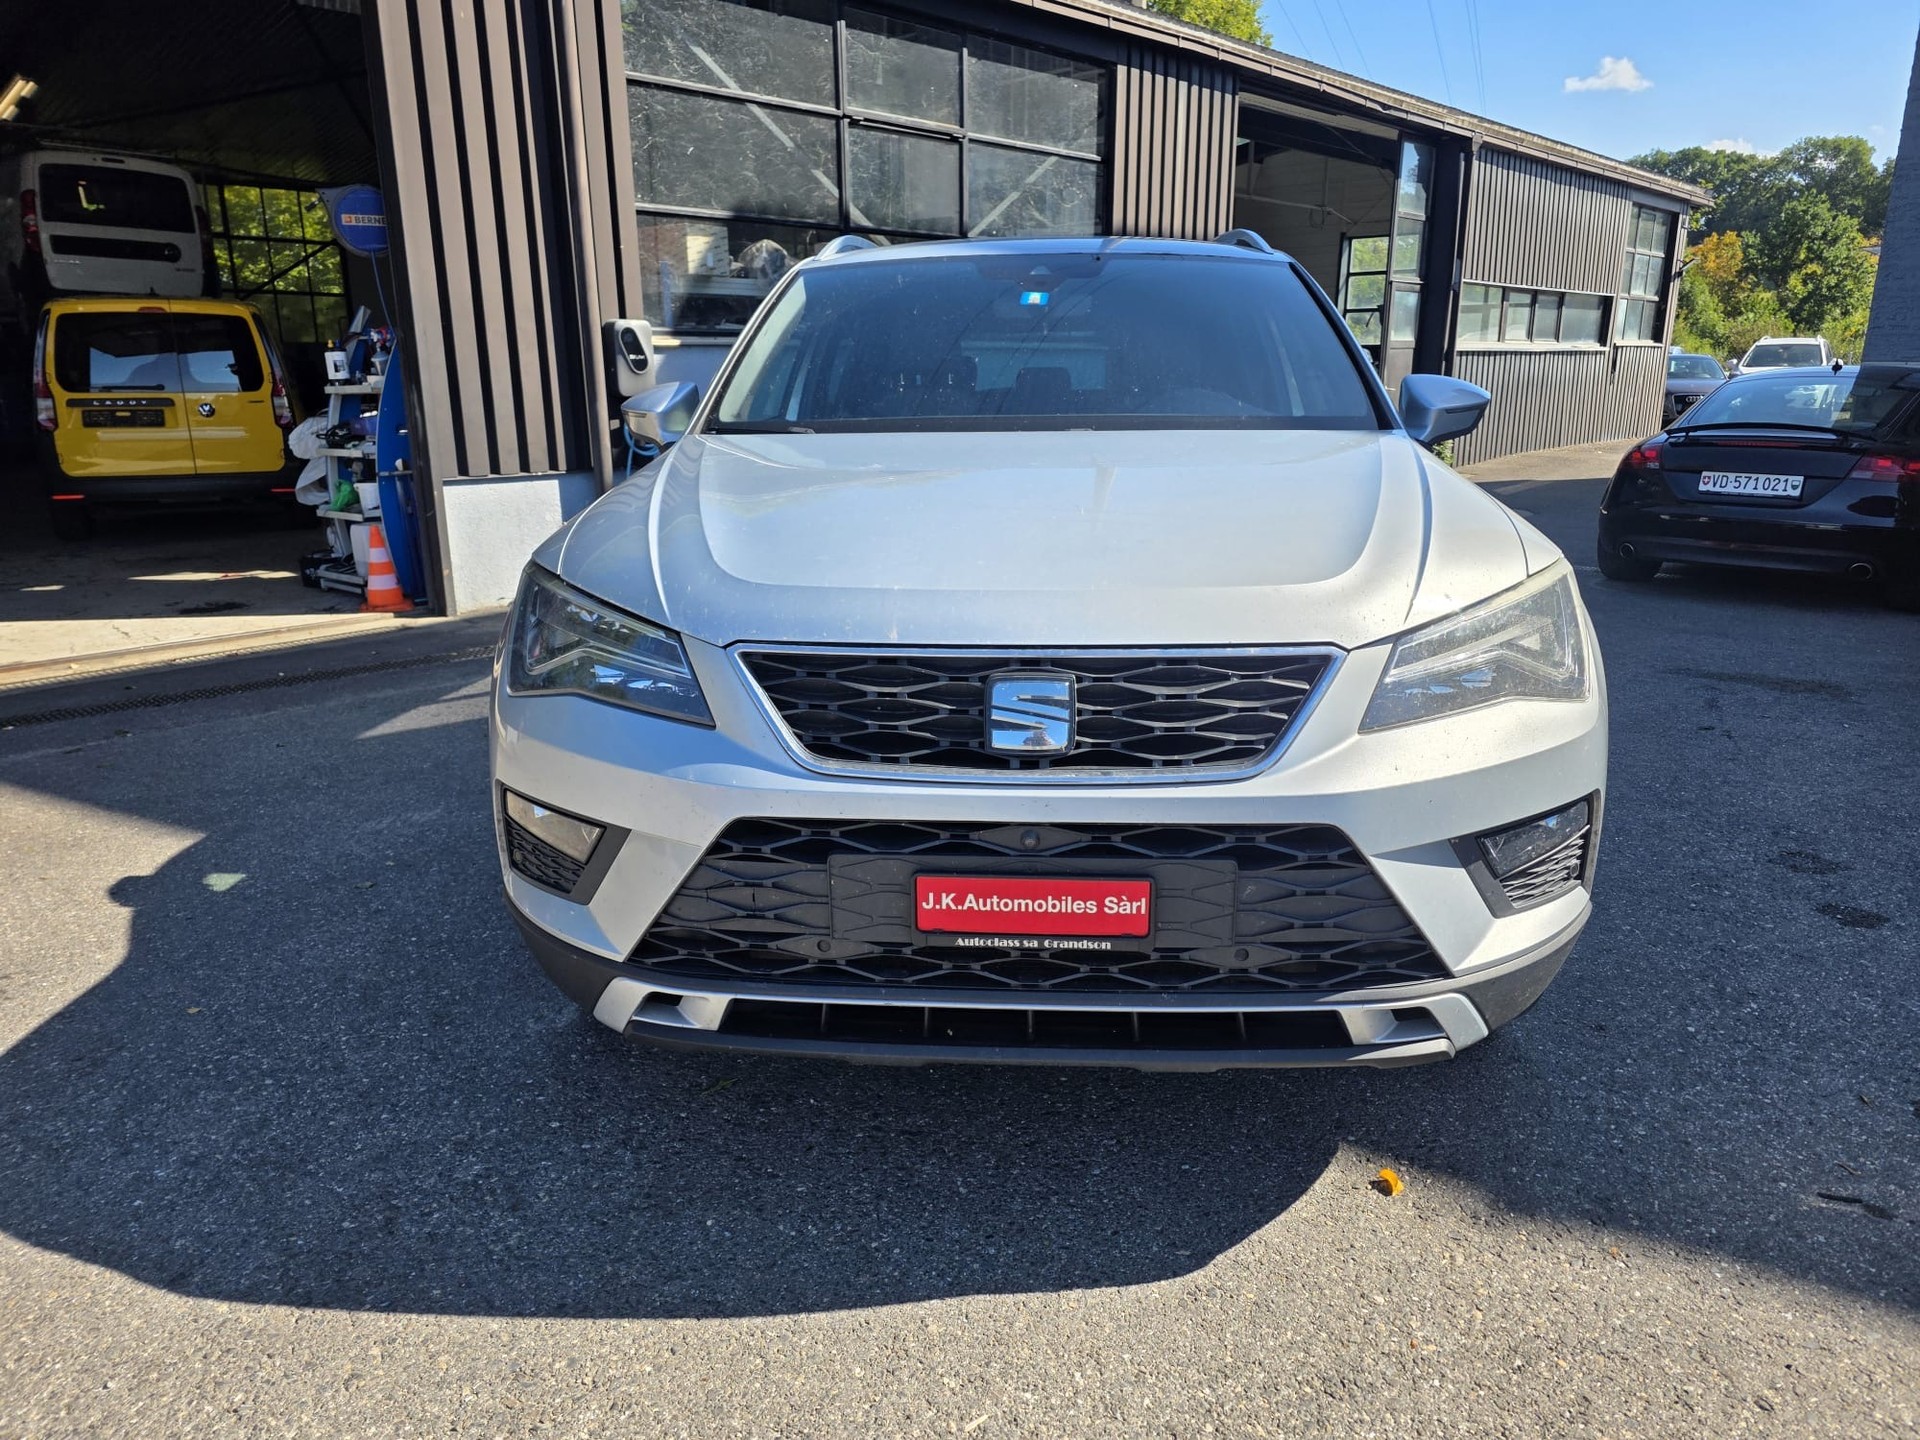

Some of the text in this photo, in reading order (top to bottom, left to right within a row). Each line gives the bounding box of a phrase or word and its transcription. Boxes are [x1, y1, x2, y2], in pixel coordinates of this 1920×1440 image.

[1104, 895, 1146, 915] Sàrl
[955, 937, 1111, 951] Autoclass sa Grandson
